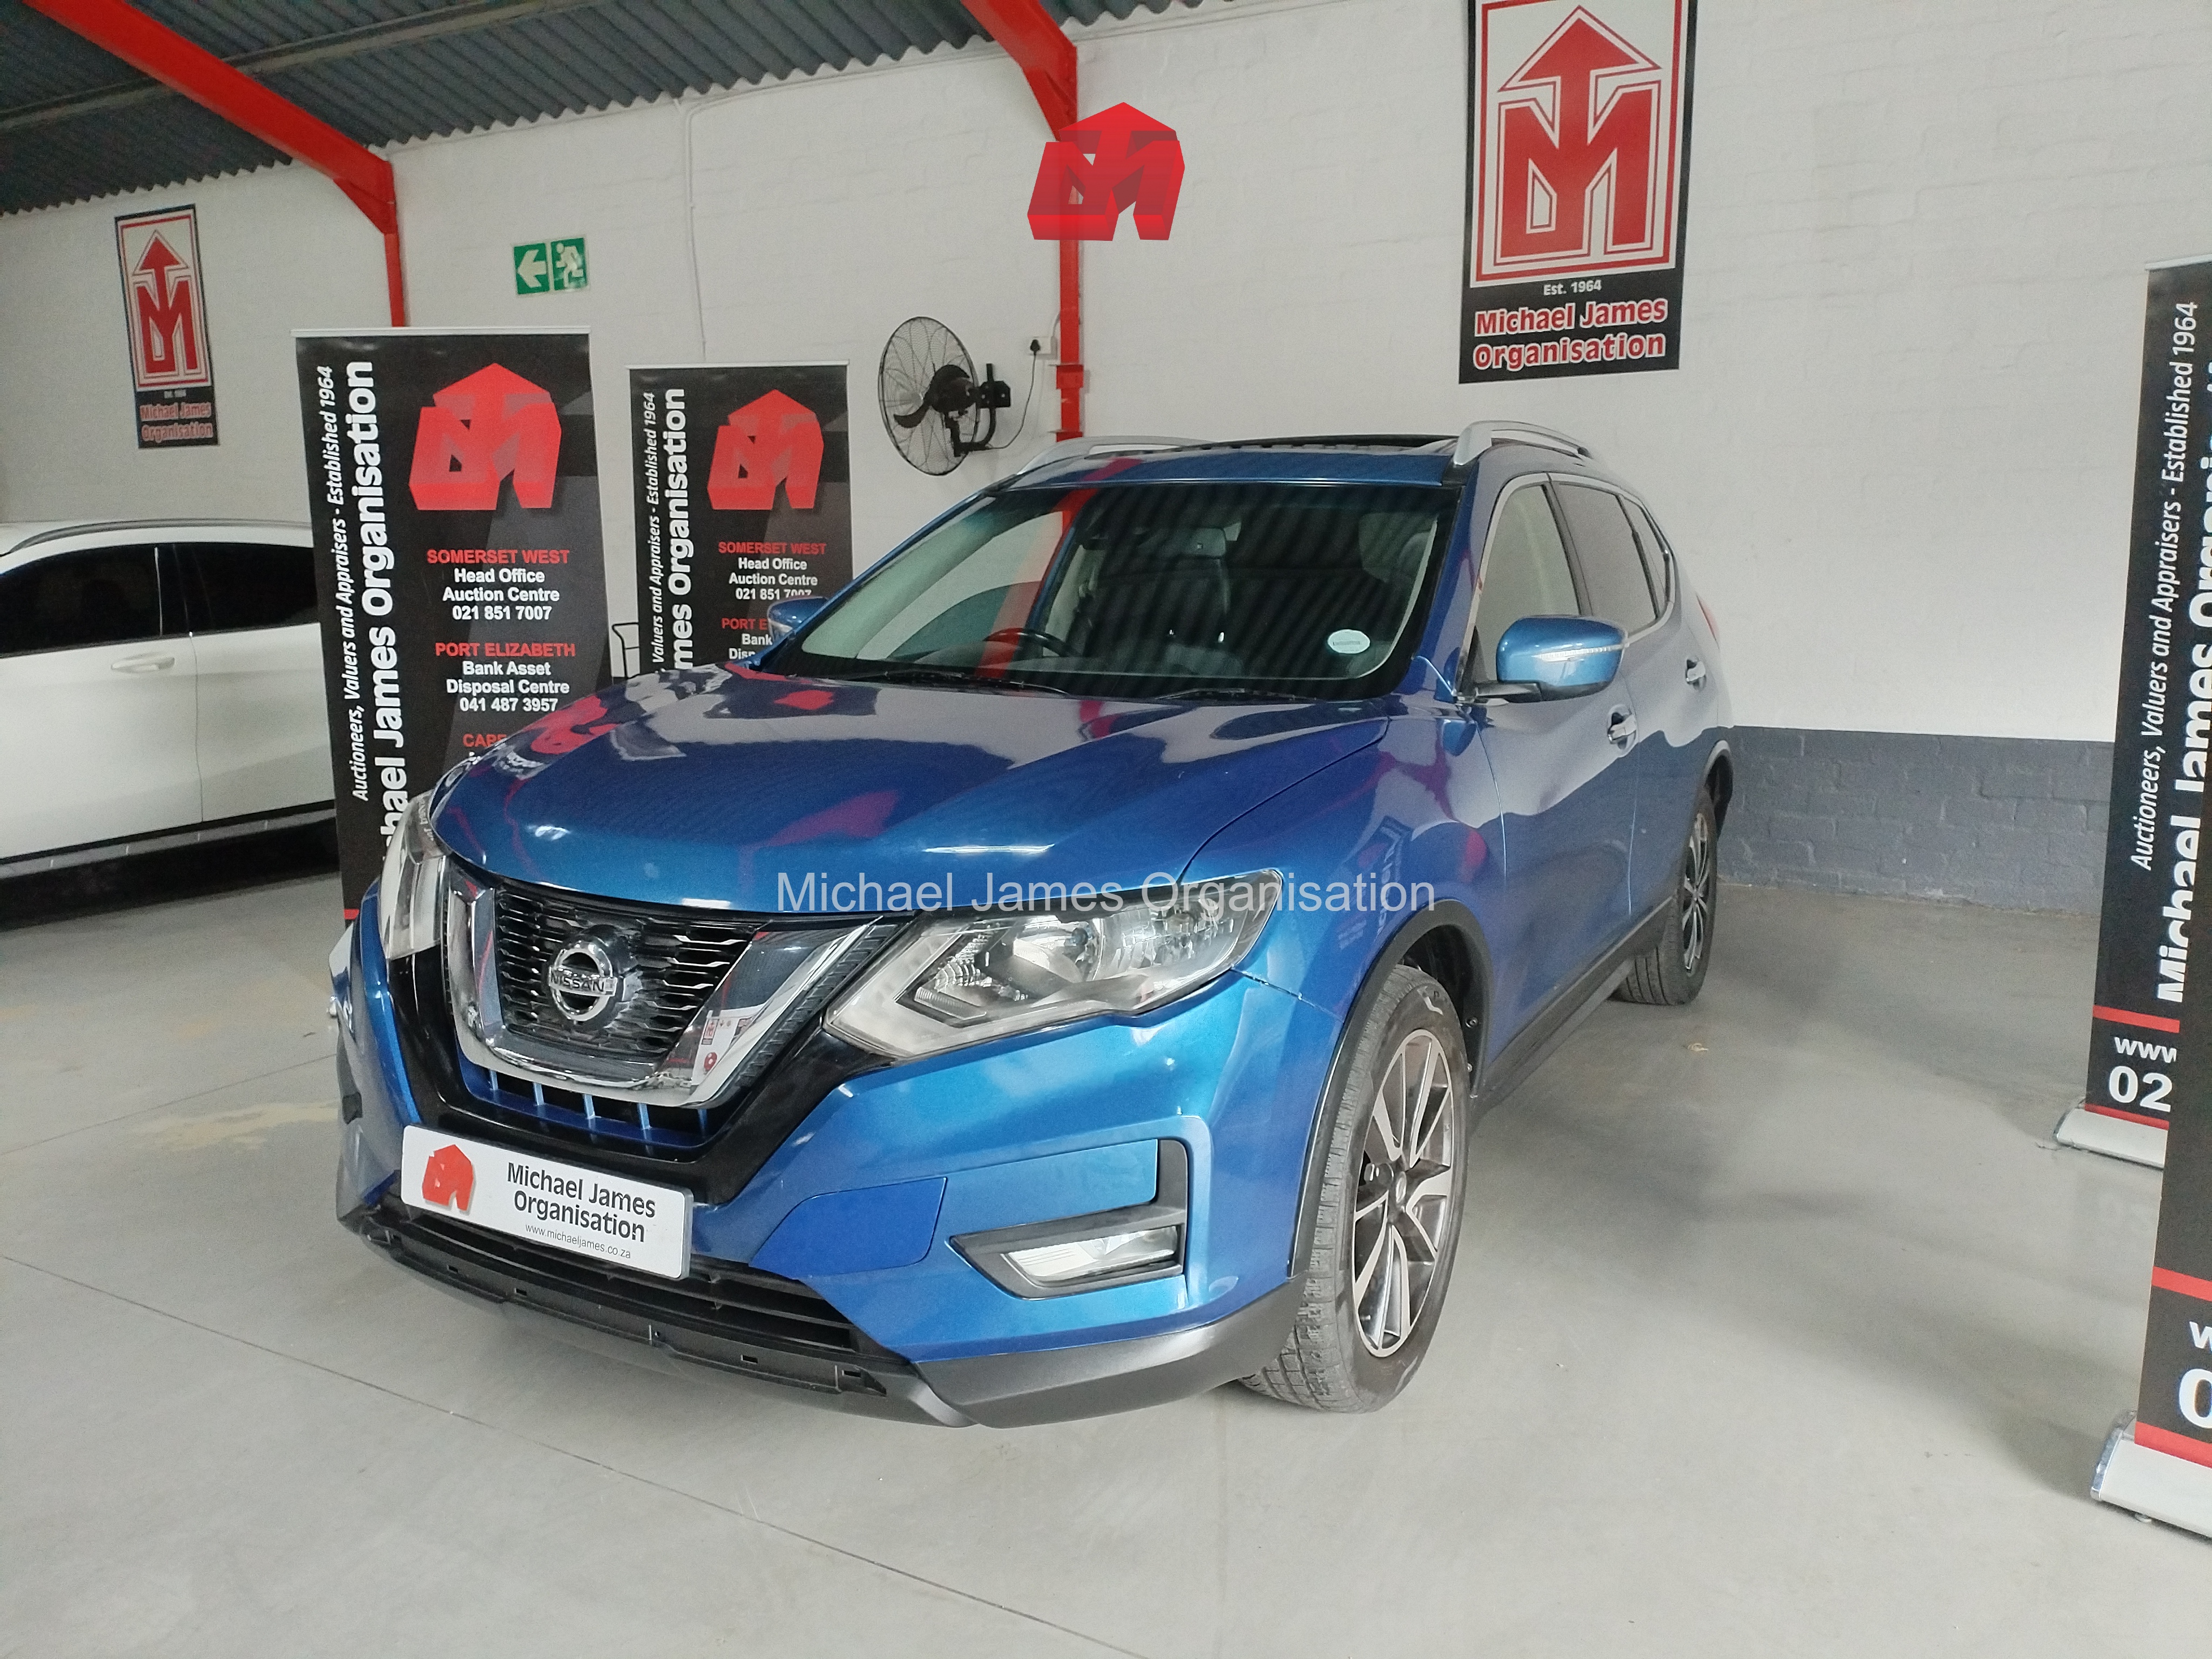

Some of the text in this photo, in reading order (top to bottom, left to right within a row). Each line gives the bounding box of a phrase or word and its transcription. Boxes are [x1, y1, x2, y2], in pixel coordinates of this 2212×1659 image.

[1543, 279, 1602, 296] Est. 1964
[1475, 298, 1669, 337] Michael James
[2172, 301, 2198, 355] 1964
[1473, 332, 1667, 371] Organisation
[316, 366, 335, 407] 1964
[643, 392, 656, 426] 1964
[2161, 361, 2193, 482] Established
[319, 410, 345, 505] Established
[643, 428, 659, 505] Established
[663, 388, 694, 595] Organisation
[331, 518, 355, 604] Appraisers
[427, 549, 570, 564] SOMERSET WEST
[648, 515, 664, 586] Appraisers
[718, 542, 827, 555] SOMERSET WEST
[738, 557, 807, 570] Head Office
[2150, 501, 2182, 612] Appraisers
[442, 586, 560, 602] Auction Centre
[454, 568, 545, 583] Head Office
[729, 572, 818, 585] Auction Centre
[736, 588, 756, 599] 021
[760, 588, 780, 600] 851
[345, 361, 409, 848] hael James Organisation
[452, 605, 552, 620] 021 851 7007
[649, 586, 663, 613] and
[335, 605, 356, 639] and
[651, 615, 665, 663] Valuers
[721, 618, 756, 630] PORT
[741, 633, 773, 645] Bank
[2148, 614, 2172, 657] and
[435, 642, 576, 657] PORT ELIZABETH
[462, 660, 551, 675] Bank Asset
[341, 640, 361, 699] Valuers
[446, 679, 570, 696] Disposal Centre
[460, 697, 558, 712] 041 487 3957
[2141, 661, 2168, 736] Valuers
[348, 704, 369, 801] Auctioneers,
[2130, 746, 2166, 871] Auctioneers,
[550, 972, 604, 992] NISSAN
[507, 1162, 656, 1218] Michael James
[514, 1190, 645, 1243] Organisation
[525, 1224, 631, 1259] www.michaeljames.co.za
